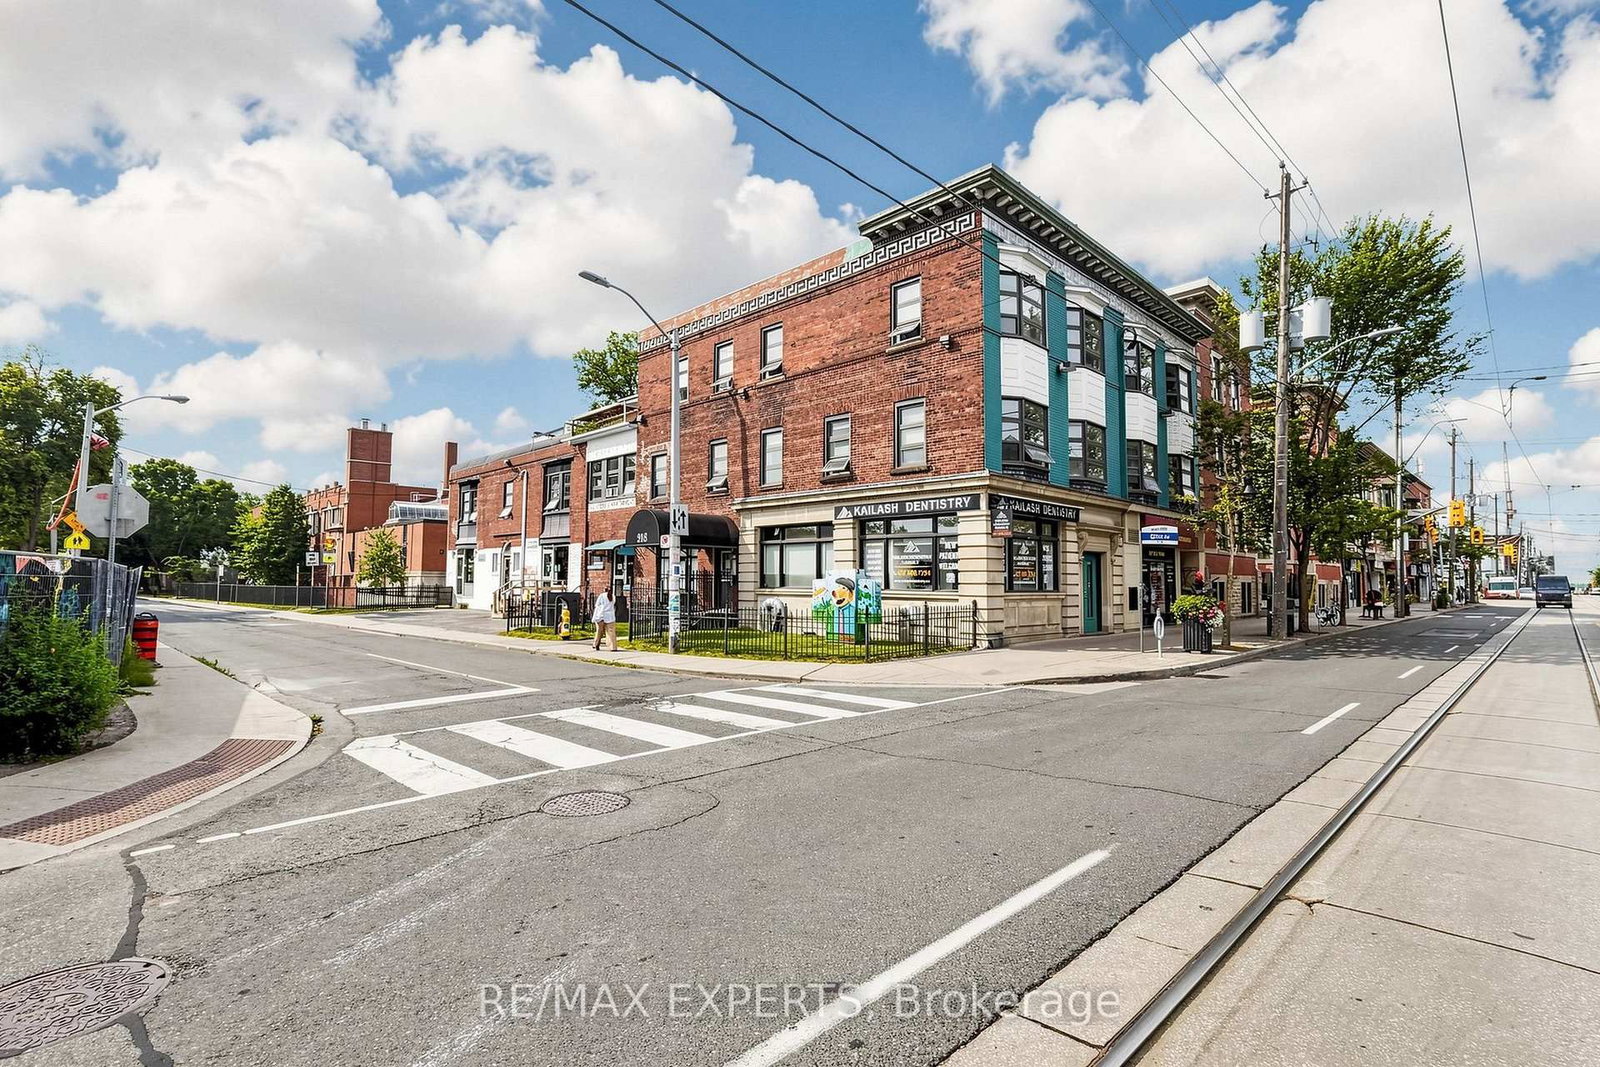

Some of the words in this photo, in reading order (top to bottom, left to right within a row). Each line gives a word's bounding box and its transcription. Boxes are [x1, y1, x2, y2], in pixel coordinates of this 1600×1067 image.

[853, 502, 899, 517] KAILASH
[905, 496, 972, 513] DENTISTRY
[1009, 500, 1041, 514] KAILASH
[1043, 504, 1077, 519] DENTISTRY
